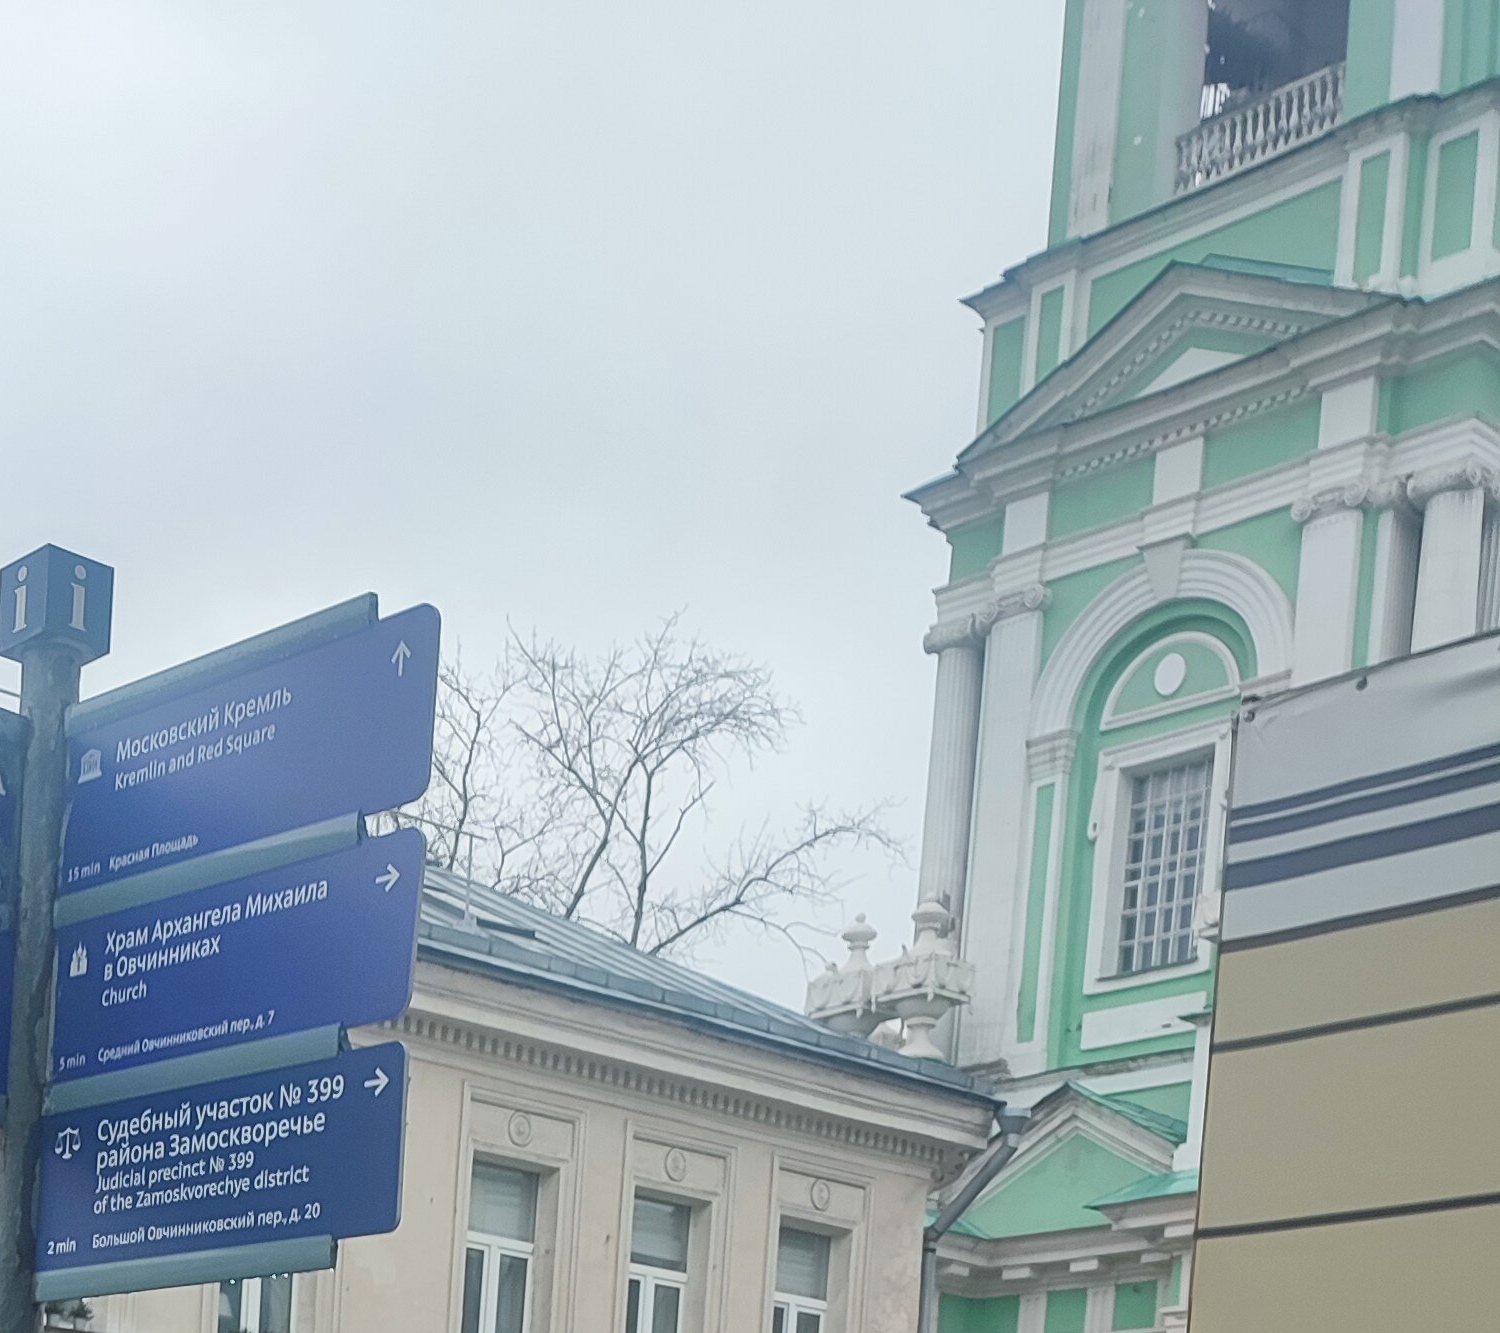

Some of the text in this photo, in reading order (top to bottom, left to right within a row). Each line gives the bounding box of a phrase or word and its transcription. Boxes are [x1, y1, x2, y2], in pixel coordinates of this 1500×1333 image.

[116, 688, 291, 762] Московский Кремль
[115, 725, 275, 791] Kremlin and Red Square
[68, 862, 100, 882] 15 min
[109, 835, 198, 871] Красная Площадь
[105, 881, 327, 957] Храм Архангела Михаила
[104, 935, 220, 981] в Овчинниках
[102, 979, 147, 1007] Church
[97, 1040, 140, 1064] Средний
[141, 1020, 227, 1052] Овчинниковский
[254, 1015, 264, 1029] д.
[267, 1010, 274, 1024] 7
[59, 1054, 85, 1070] 5 min
[97, 1075, 344, 1145] Судебный участок № 399
[96, 1113, 325, 1175] района Замоскворечье
[93, 1166, 309, 1214] of the Zamoskvorechye district
[95, 1151, 254, 1193] Judicial precinct № 399
[47, 1238, 76, 1254] 2 min
[92, 1227, 144, 1248] Большой
[147, 1211, 254, 1240] Овчинниковский
[288, 1208, 300, 1224] д.
[304, 1203, 320, 1219] 20
